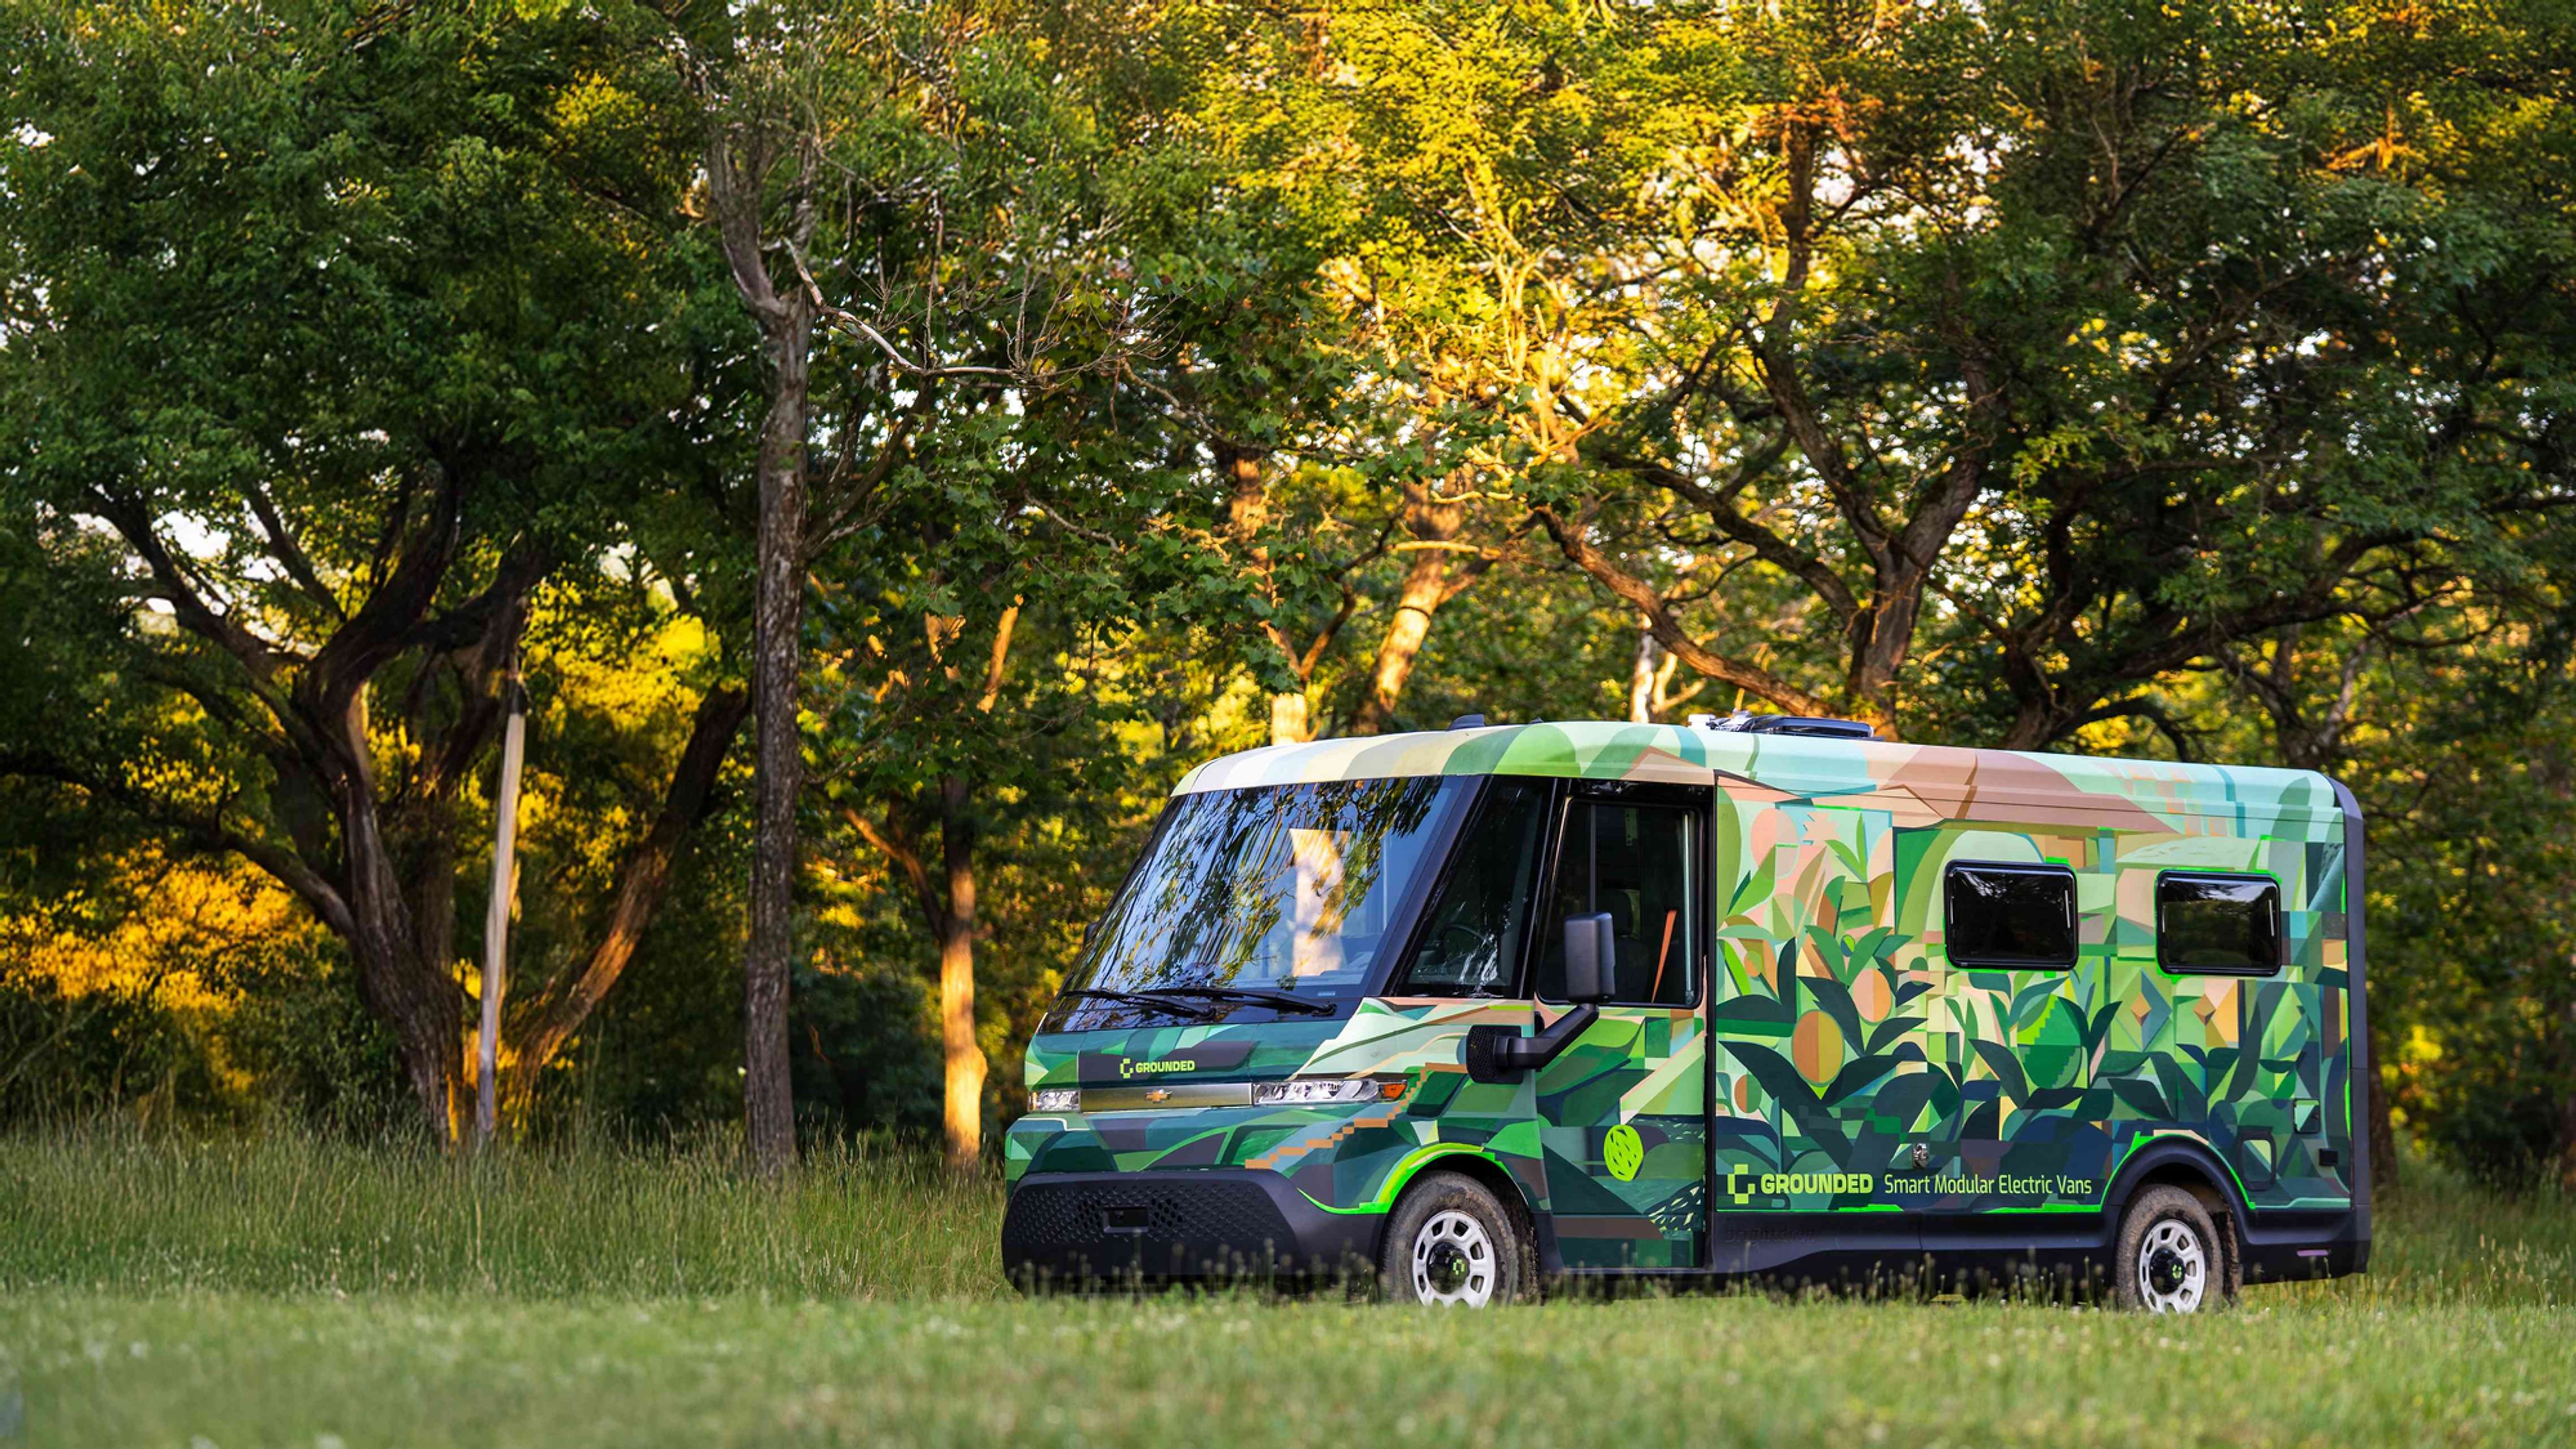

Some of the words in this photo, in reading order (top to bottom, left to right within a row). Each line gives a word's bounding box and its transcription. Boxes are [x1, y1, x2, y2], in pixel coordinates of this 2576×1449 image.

[1136, 1060, 1195, 1073] GROUNDED
[1761, 1173, 1873, 1194] GROUNDED
[1884, 1174, 1930, 1194] Smart
[1934, 1174, 1995, 1194] Modular
[1999, 1174, 2053, 1194] Electric
[2057, 1175, 2092, 1194] Vans
